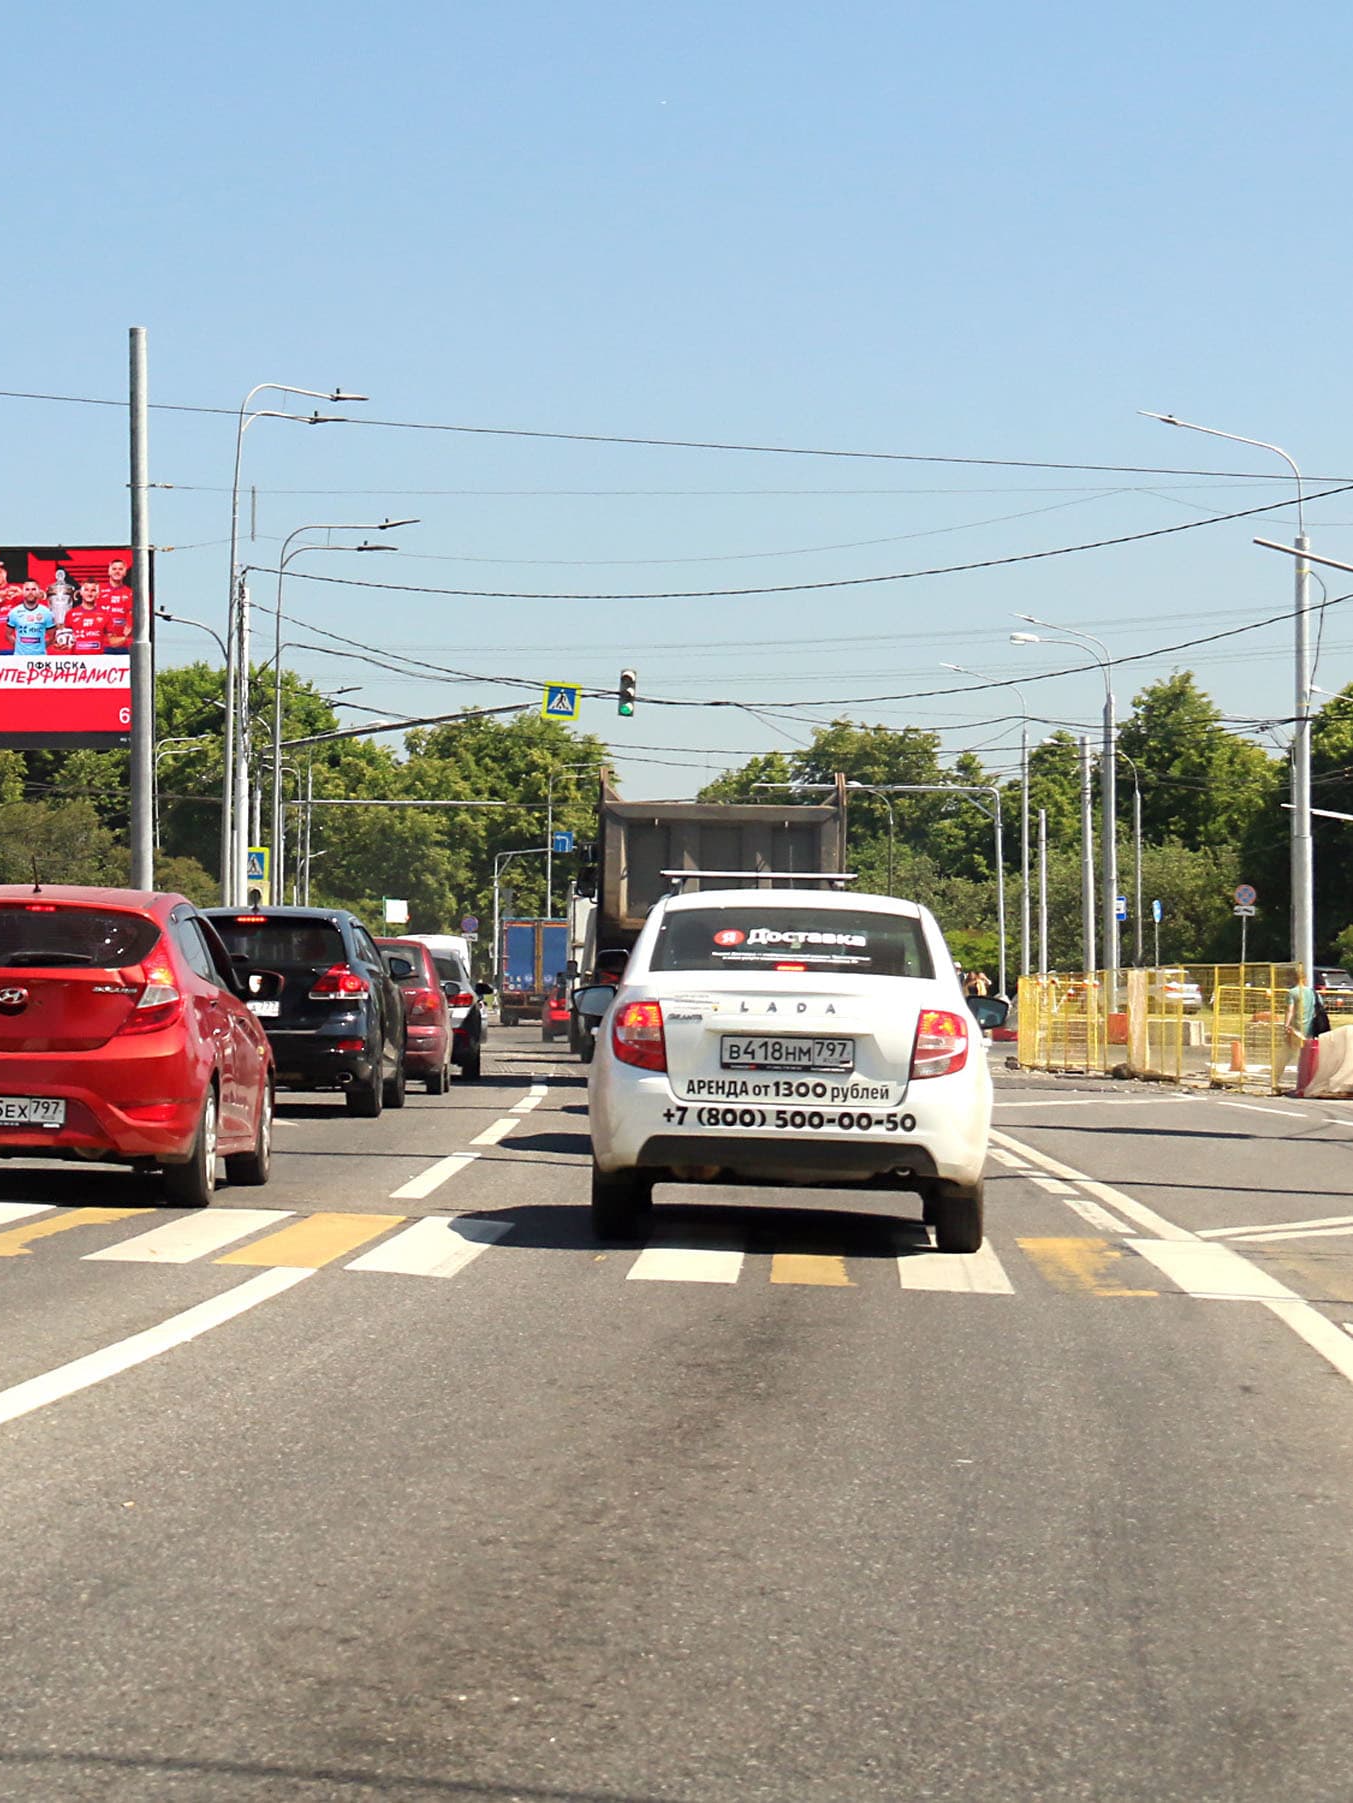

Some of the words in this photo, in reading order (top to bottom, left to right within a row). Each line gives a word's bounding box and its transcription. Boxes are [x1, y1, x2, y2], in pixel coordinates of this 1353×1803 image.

[26, 661, 51, 670] ПФК
[55, 661, 86, 671] ЦСКА
[747, 928, 866, 947] Доставка
[740, 1001, 836, 1014] LADA
[729, 1041, 812, 1062] В418НМ
[815, 1042, 847, 1057] 797
[687, 1080, 749, 1098] АРЕНДА
[752, 1084, 770, 1096] от
[774, 1081, 827, 1098] 1300
[831, 1083, 889, 1102] рублей
[32, 1101, 60, 1114] 797
[663, 1107, 689, 1126] +7
[697, 1108, 767, 1127] (800)
[775, 1110, 917, 1132] 500-00-50
